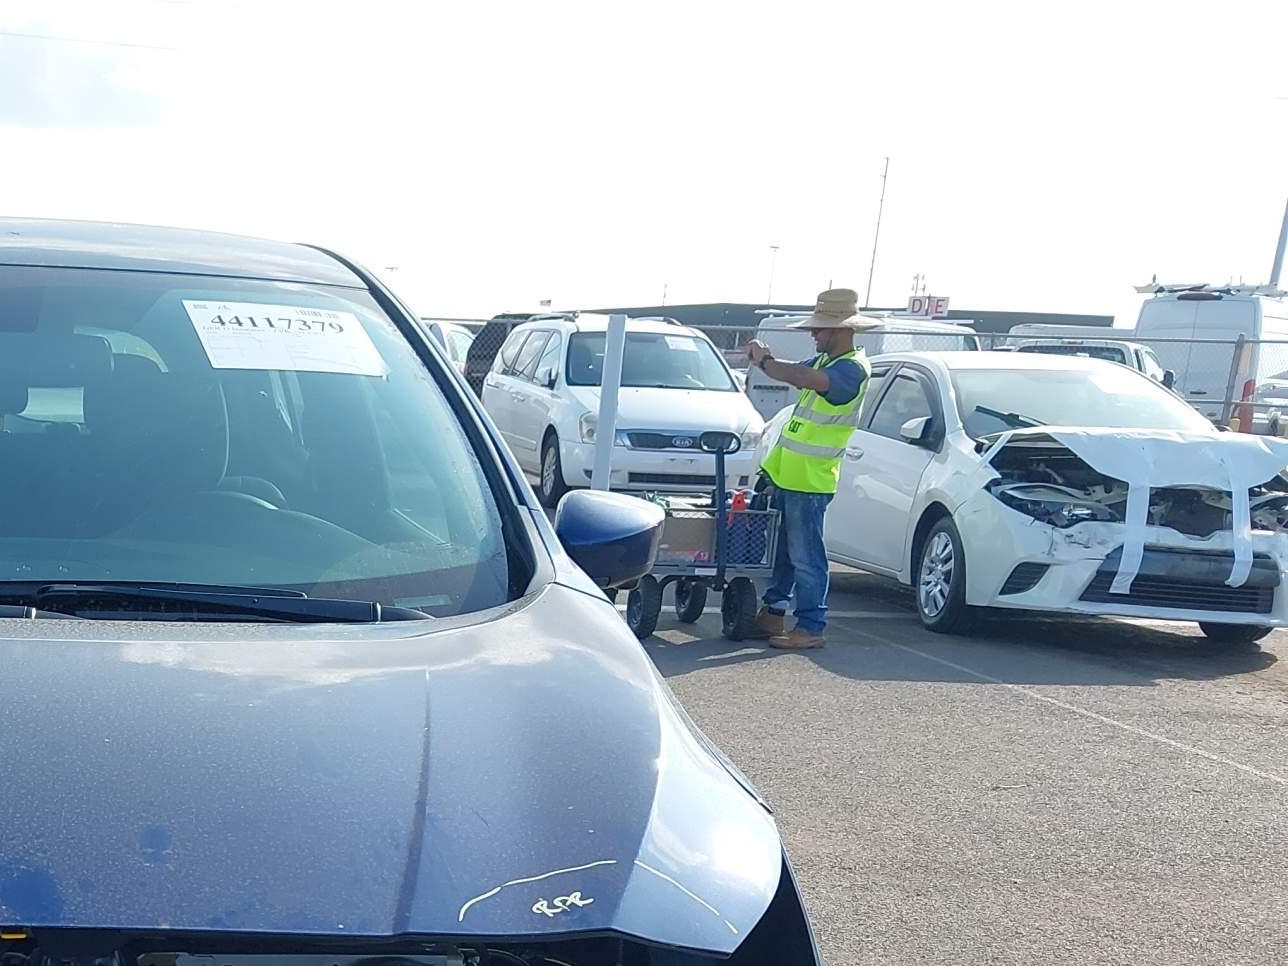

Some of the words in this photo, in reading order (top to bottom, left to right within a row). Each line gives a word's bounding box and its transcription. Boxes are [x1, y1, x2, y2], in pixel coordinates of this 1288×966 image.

[912, 298, 923, 313] D
[934, 299, 945, 313] E
[210, 314, 344, 334] 44117379
